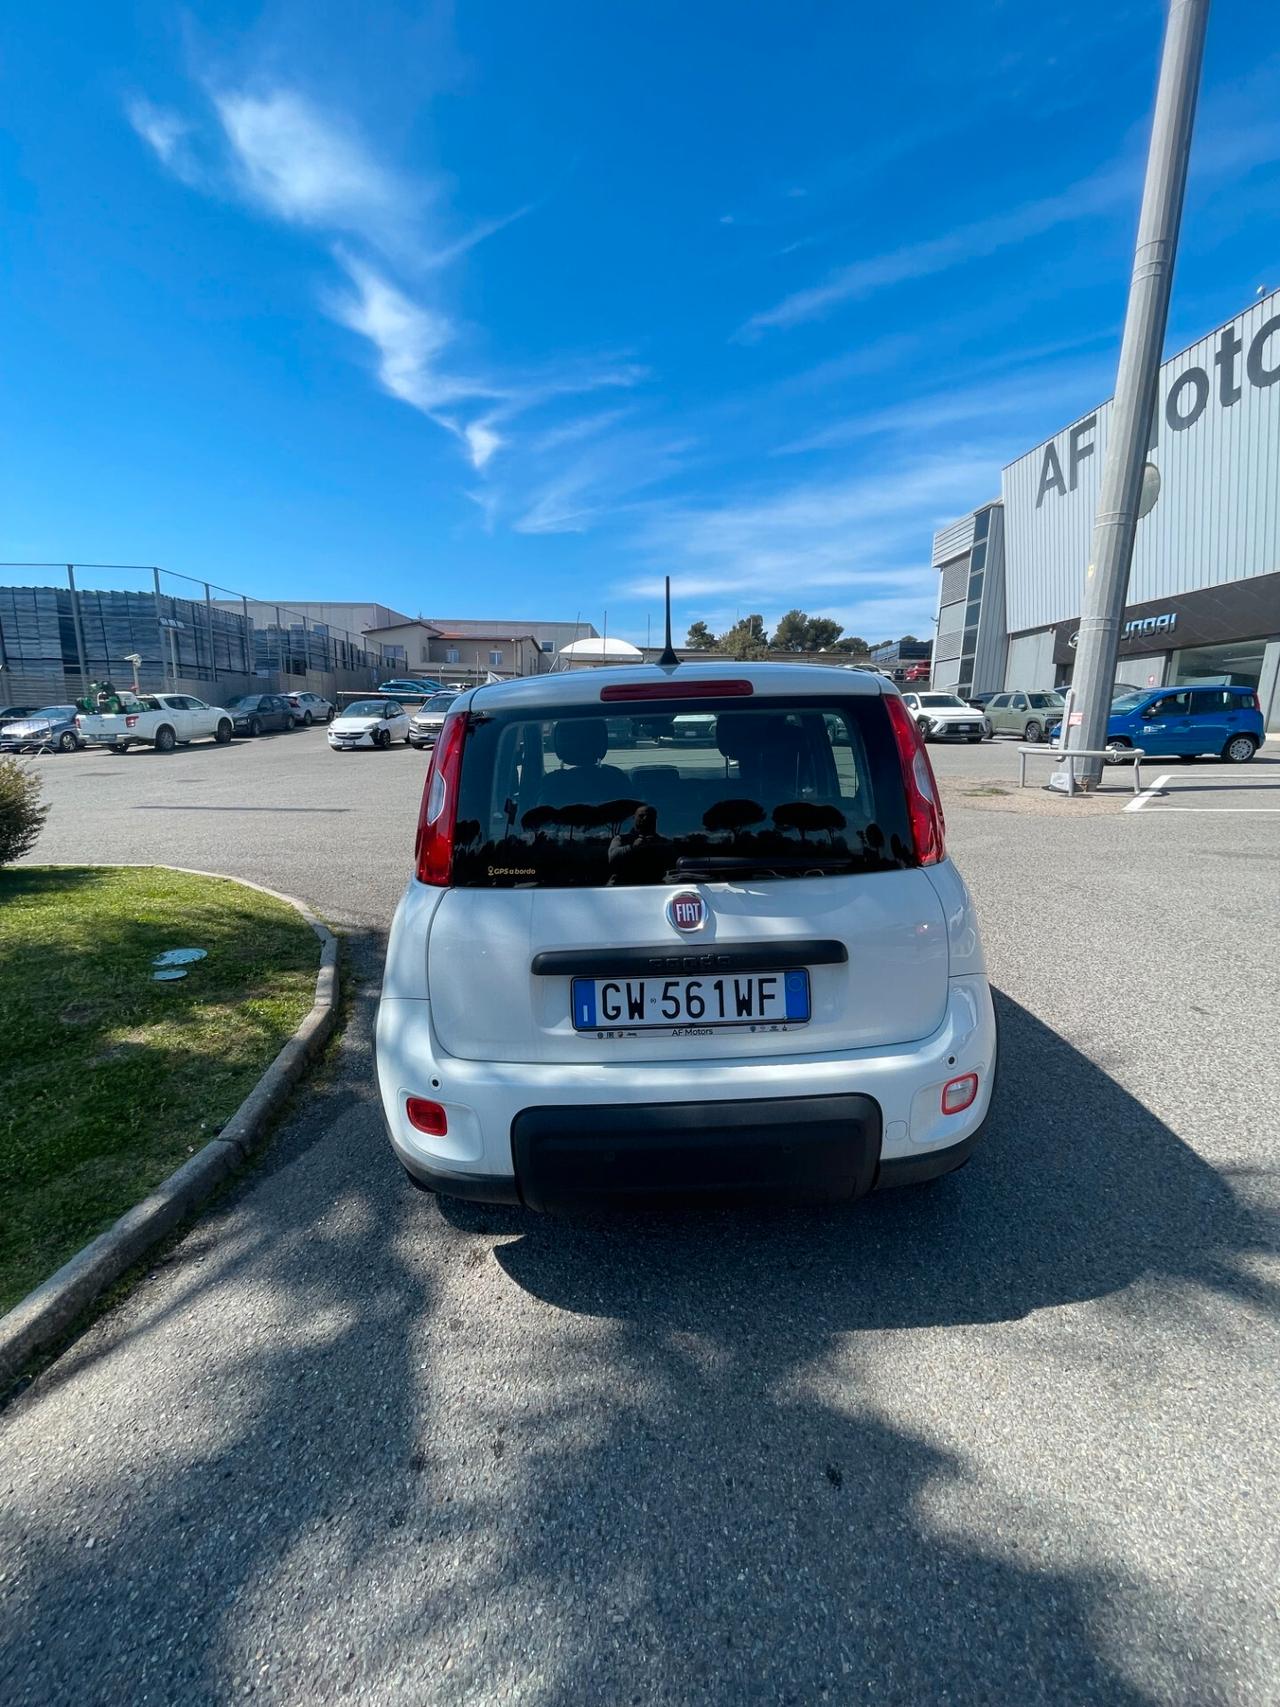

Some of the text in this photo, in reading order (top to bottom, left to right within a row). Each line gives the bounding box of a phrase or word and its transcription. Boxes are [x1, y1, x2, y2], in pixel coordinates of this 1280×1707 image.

[1036, 314, 1280, 508] AF oto
[676, 903, 700, 922] FIAT
[602, 982, 645, 1021] GW
[661, 978, 777, 1019] 561WF
[685, 1028, 713, 1036] Motors
